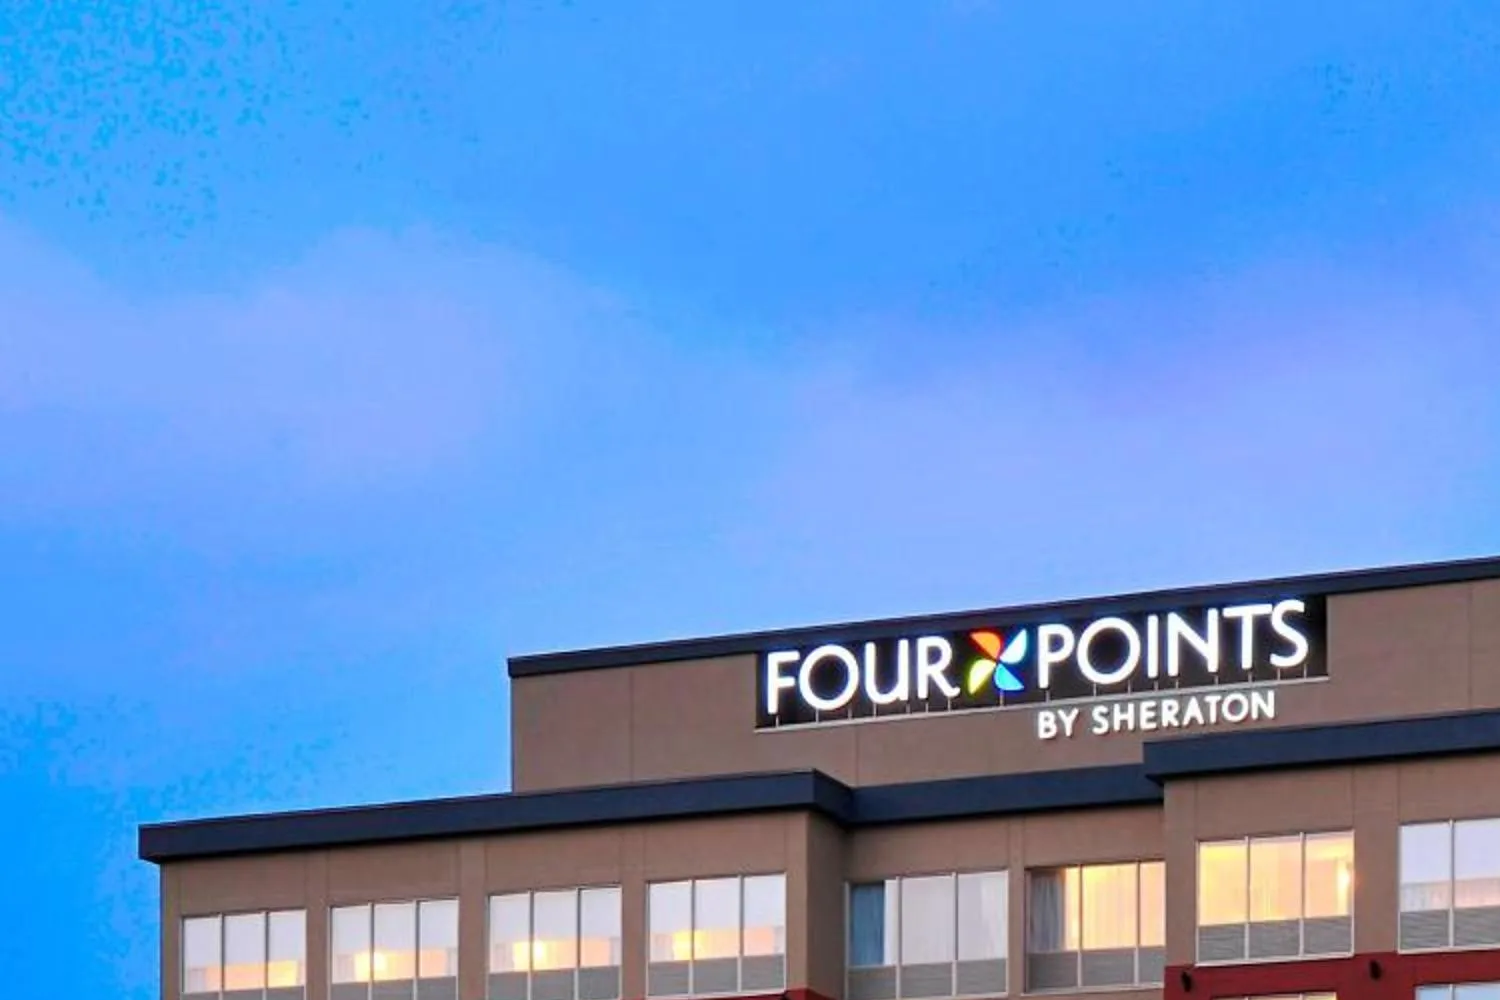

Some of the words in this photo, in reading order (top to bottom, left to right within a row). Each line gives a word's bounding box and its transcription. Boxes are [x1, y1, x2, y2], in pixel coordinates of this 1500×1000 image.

[765, 636, 960, 716] FOUR
[1036, 599, 1310, 690] POINTS
[1036, 709, 1080, 740] BY
[1091, 690, 1277, 734] SHERATON
